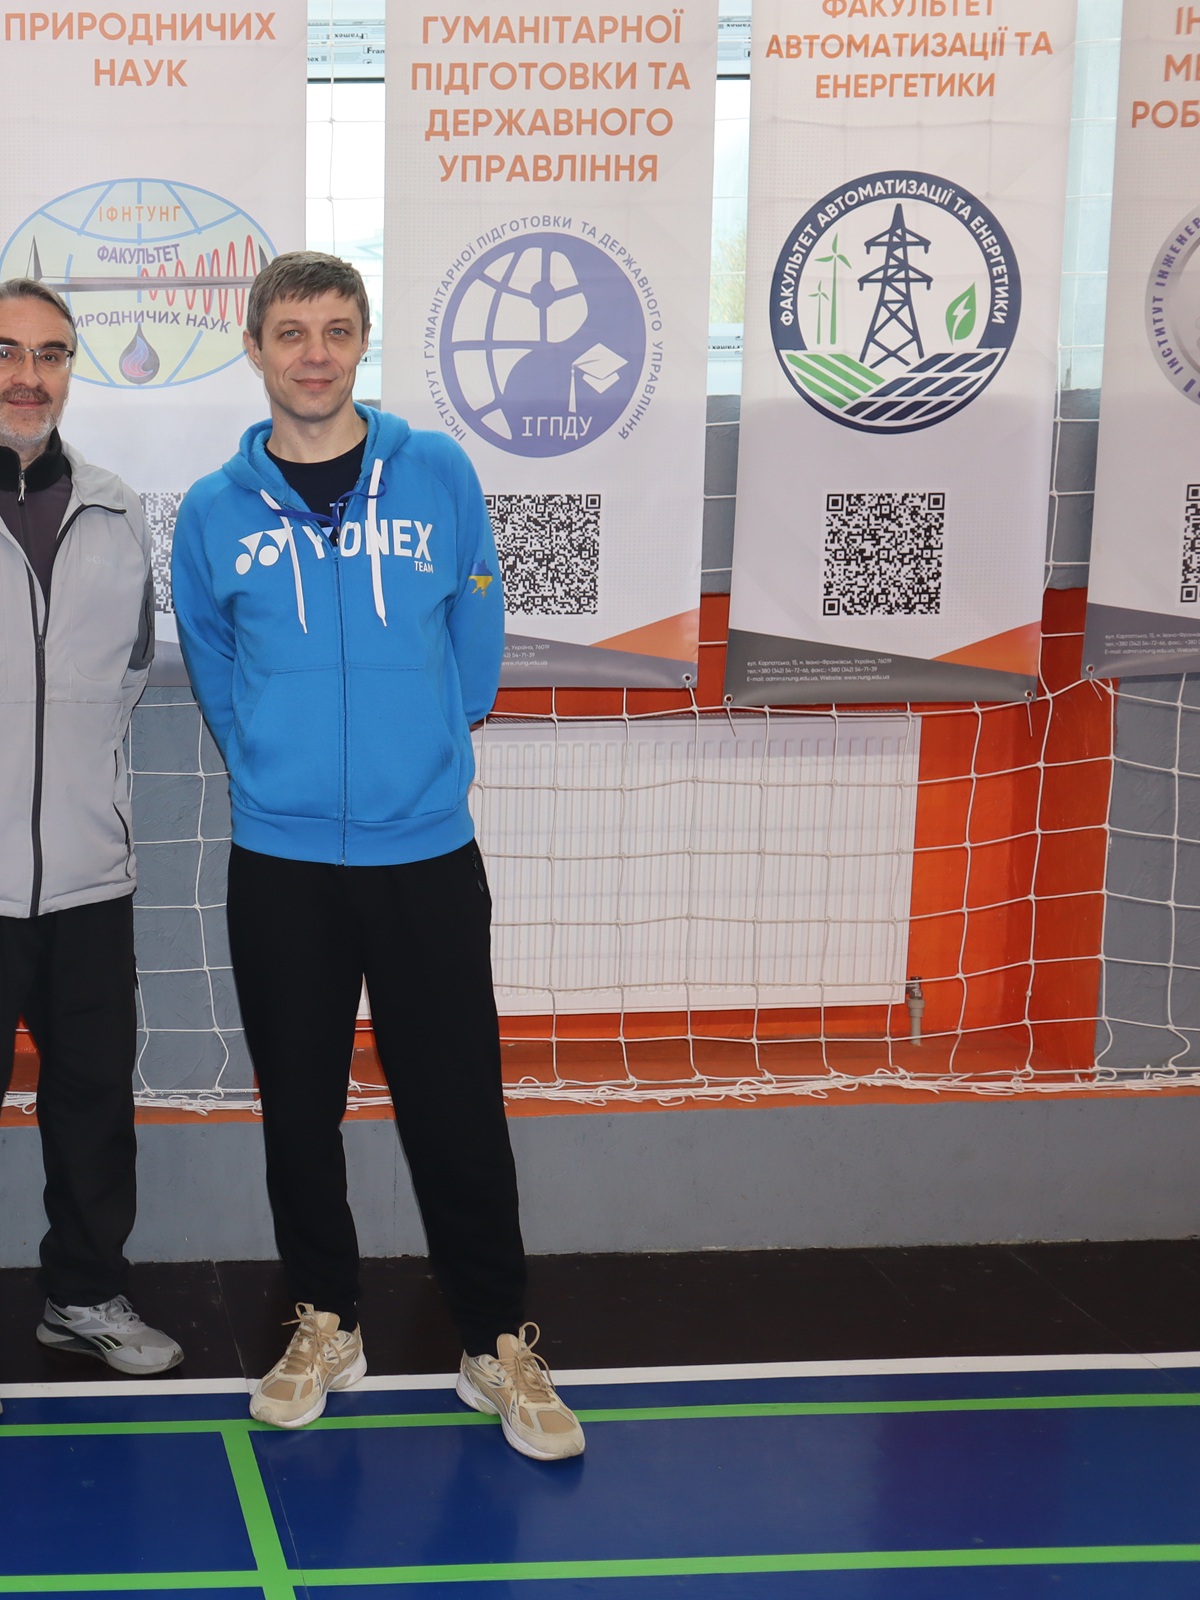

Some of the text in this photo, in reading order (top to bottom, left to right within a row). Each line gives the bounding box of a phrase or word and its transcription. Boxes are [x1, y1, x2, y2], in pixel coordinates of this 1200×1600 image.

[822, 0, 994, 18] ФАКУЛЬТЕТ
[5, 12, 276, 45] ПРИРОДНИЧИХ
[422, 9, 684, 44] ГУМАНІТАРНОЇ
[765, 26, 1054, 60] АВТОМАТИЗАЦІЇ ТА
[94, 59, 188, 87] НАУК
[411, 62, 691, 95] ПІДГОТОВКИ ТА
[815, 73, 995, 98] ЕНЕРГЕТИКИ
[424, 107, 673, 141] ДЕРЖАВНОГО
[438, 154, 658, 182] УПРАВЛІННЯ
[99, 206, 182, 222] ІФНТУНГ
[97, 244, 180, 265] ФАКУЛЬТЕТ
[780, 179, 1009, 326] ФАКУЛЬТЕТ АВТОМАТИЗАЦІЇ ТА ЕНЕРГЕТИКИ
[73, 311, 231, 333] ИРОДНИЧИХ НАУК
[424, 215, 663, 441] ІНСТИТУТ ГУМАНІТАРНОЇ ПІДГОТОВКИ ТА ДЕРЖАВНОГО УПРАВЛІННЯ
[1152, 295, 1184, 375] ІНСТИТУТ
[522, 416, 593, 440] ІГПДУ
[302, 519, 433, 562] YONEX
[414, 561, 434, 574] TEAM
